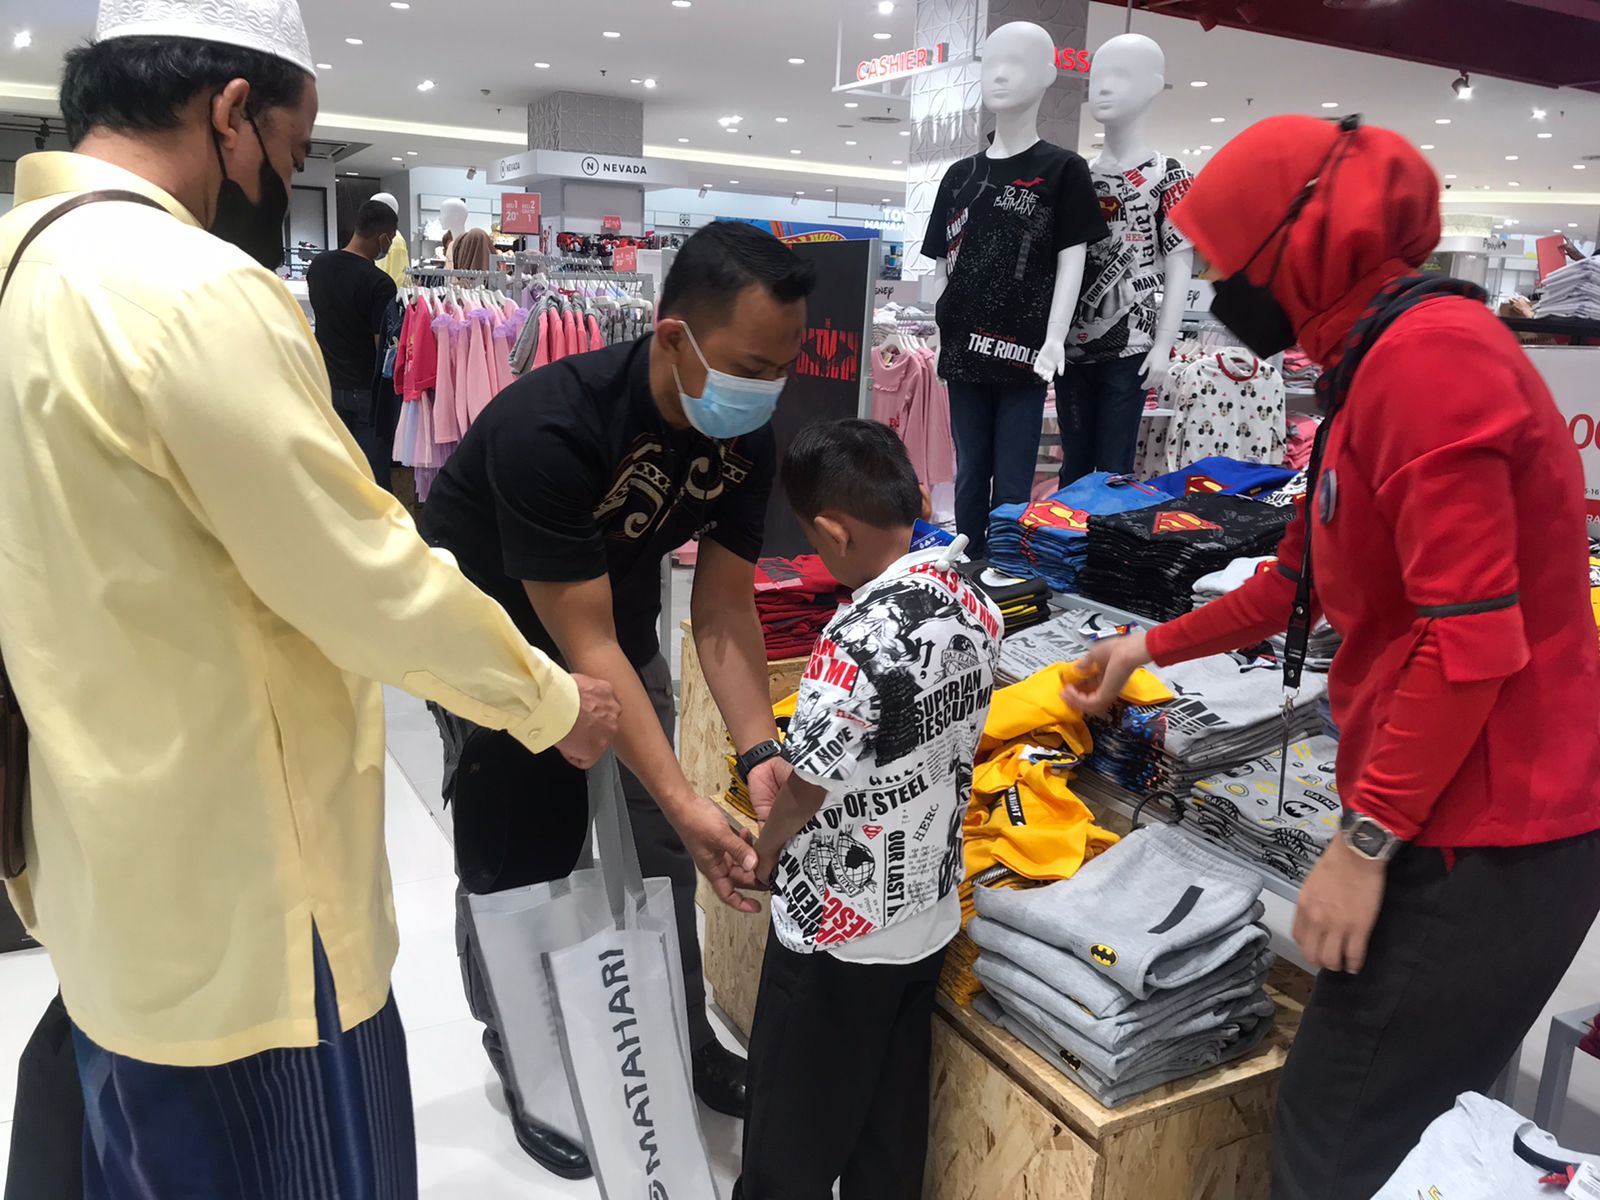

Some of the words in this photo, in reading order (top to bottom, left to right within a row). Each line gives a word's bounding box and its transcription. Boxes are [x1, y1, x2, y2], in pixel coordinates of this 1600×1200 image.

[857, 48, 927, 81] CASHIER
[937, 43, 944, 65] 1
[603, 164, 647, 175] NEVADA
[994, 196, 1036, 216] BATMAN
[1003, 185, 1016, 199] TO
[1018, 188, 1040, 204] THE
[1086, 283, 1104, 304] OUR
[1101, 264, 1121, 286] LAST
[968, 333, 995, 355] THE
[823, 658, 859, 692] ME
[843, 793, 868, 818] OF
[872, 774, 929, 816] STEEL
[888, 830, 905, 863] OUR
[887, 864, 905, 901] LAST
[598, 948, 662, 1176] MATAHARI
